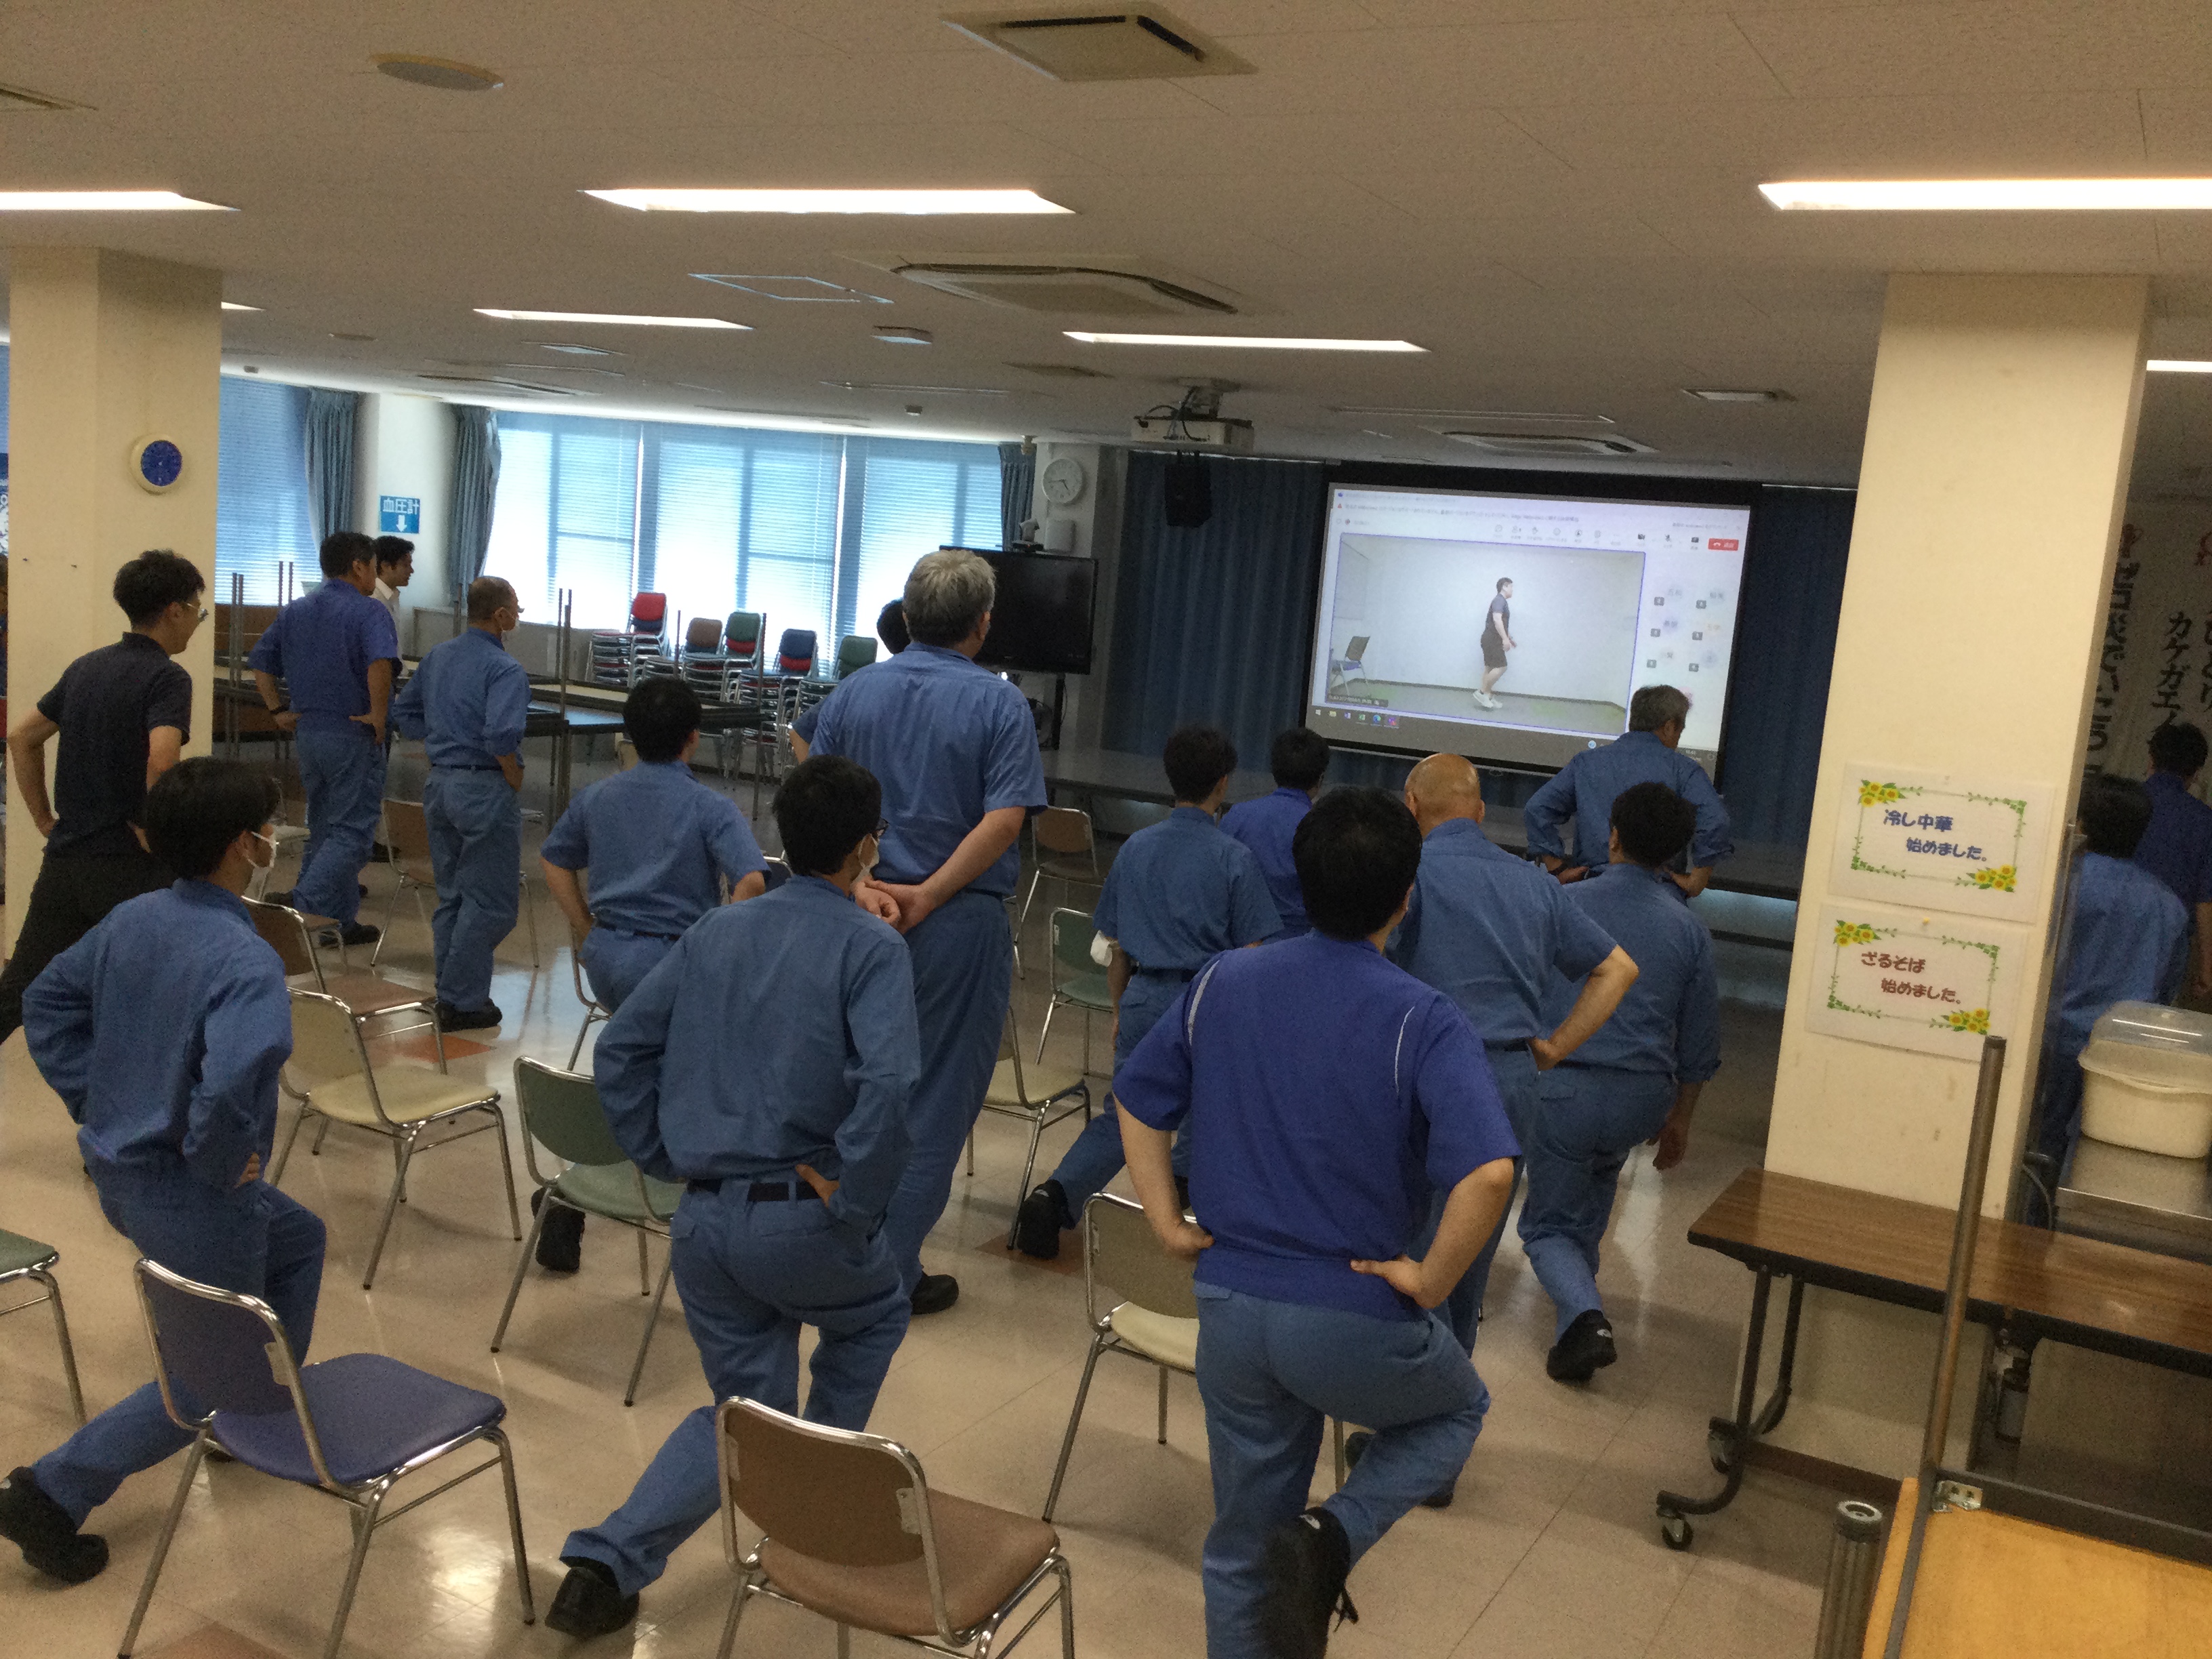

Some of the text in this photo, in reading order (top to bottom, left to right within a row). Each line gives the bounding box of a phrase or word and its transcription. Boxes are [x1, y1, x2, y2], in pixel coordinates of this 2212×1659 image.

[383, 497, 419, 515] 血圧計
[1883, 809, 1954, 833] 冷し中華
[1906, 837, 1988, 862] 始めました。
[1860, 951, 1926, 974] ざるそば
[1880, 978, 1961, 1004] 始めました。
